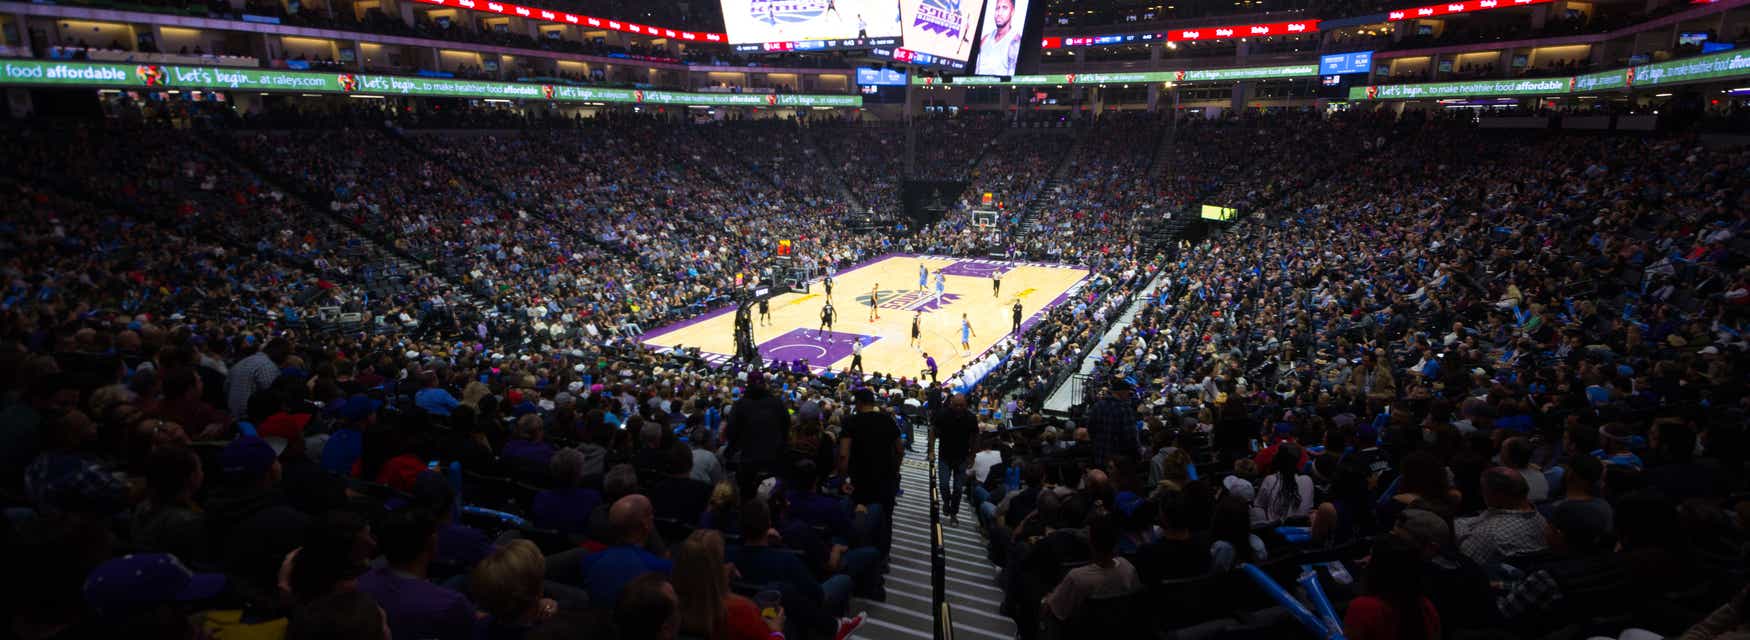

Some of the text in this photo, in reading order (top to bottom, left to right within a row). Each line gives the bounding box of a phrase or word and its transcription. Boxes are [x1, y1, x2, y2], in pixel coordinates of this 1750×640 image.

[6, 64, 126, 80] food affordable
[174, 66, 212, 84] Let's
[260, 76, 272, 84] at
[272, 76, 326, 88] raleys.com
[363, 75, 388, 90] Let's
[1382, 85, 1400, 96] Let's
[1439, 84, 1458, 93] make
[1515, 80, 1563, 91] affordable
